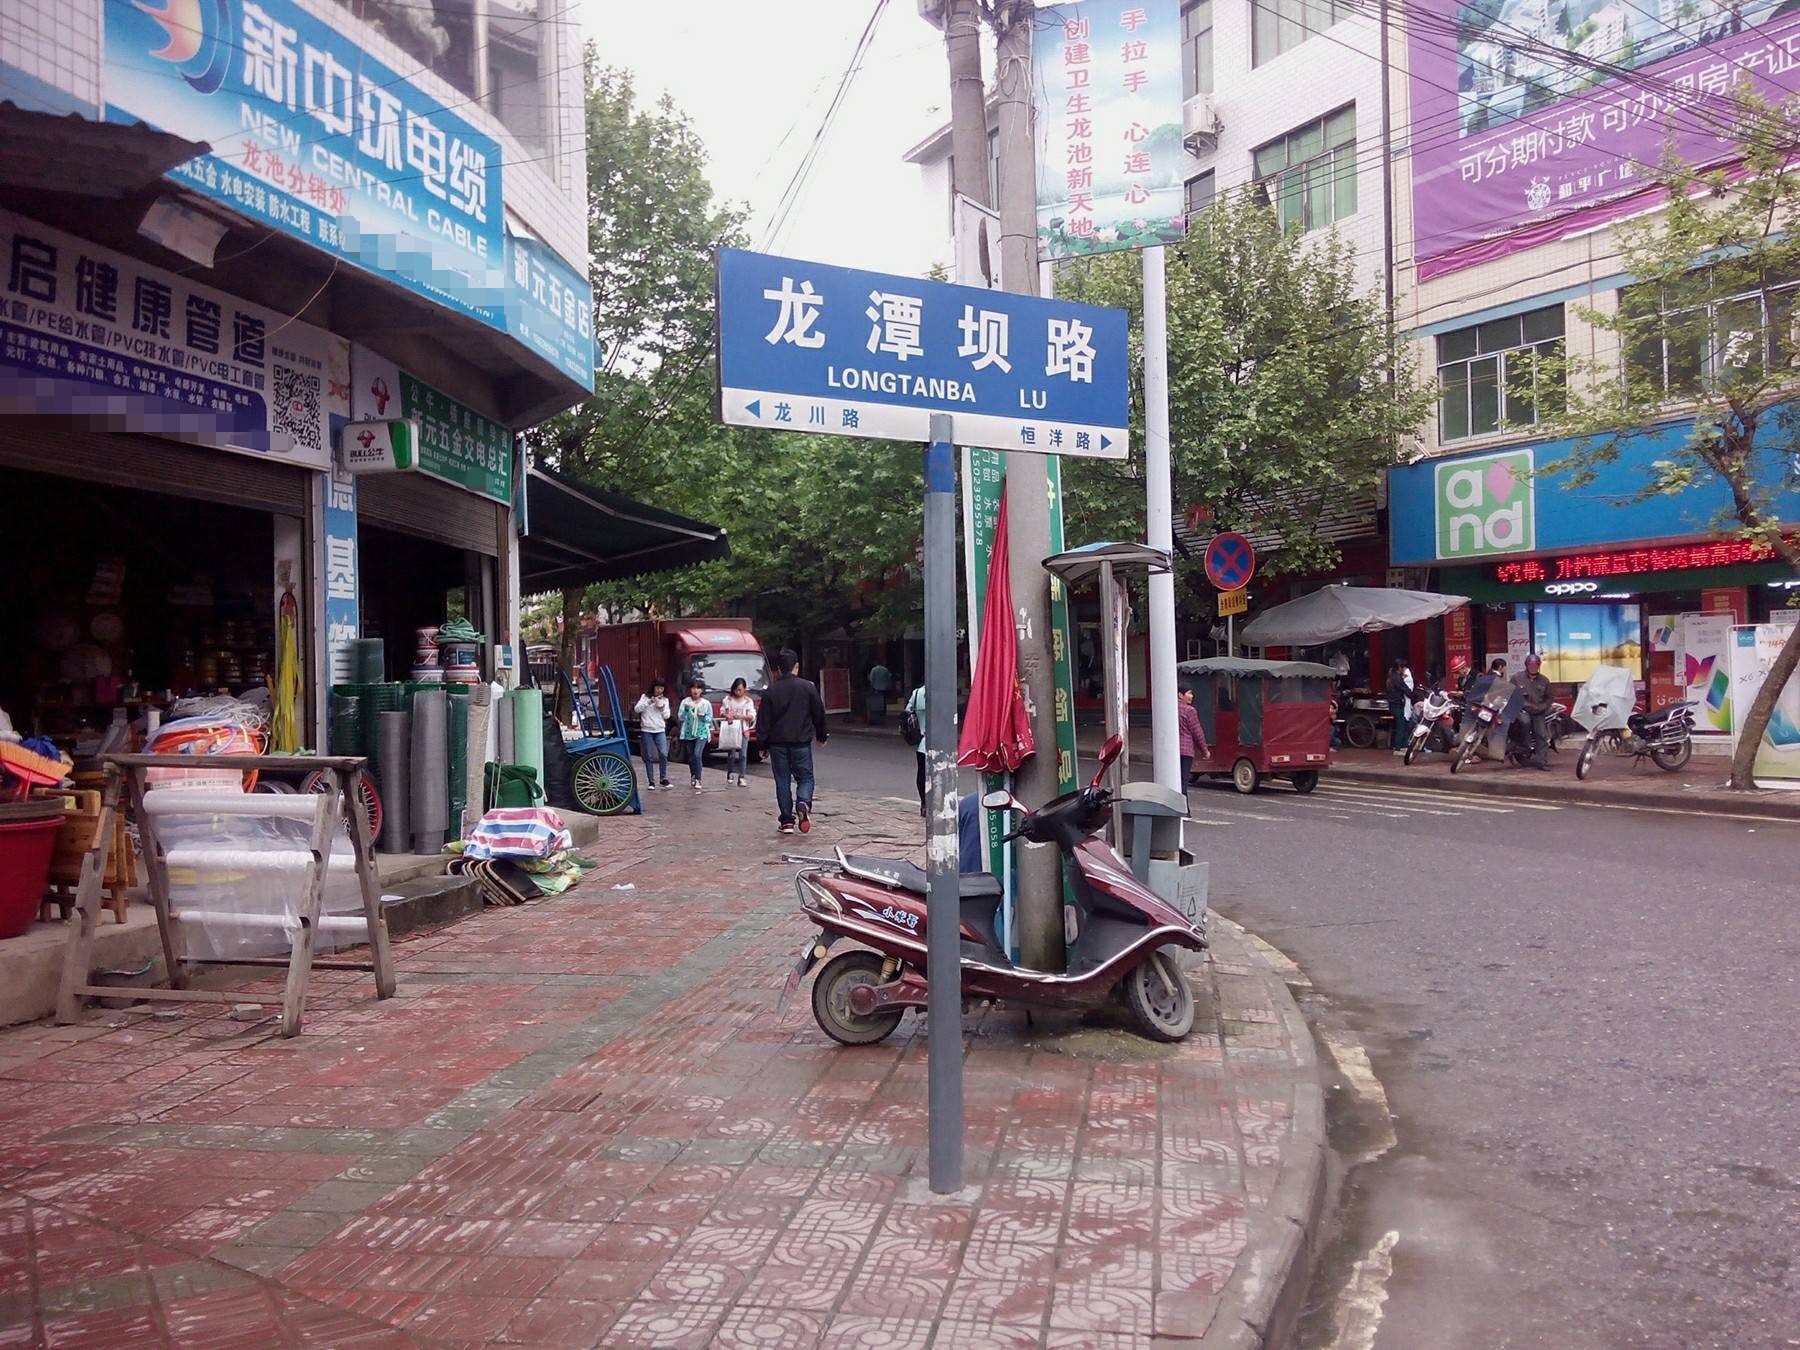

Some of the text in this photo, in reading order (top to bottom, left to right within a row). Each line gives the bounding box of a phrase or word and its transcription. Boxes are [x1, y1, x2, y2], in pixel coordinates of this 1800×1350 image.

[242, 1, 487, 223] 新中环电缆
[1064, 16, 1095, 238] 创建卫生龙池新天地
[1120, 8, 1150, 205] 手拉手 心连心
[1459, 111, 1597, 184] 可分期付款
[241, 103, 487, 258] NEW CENTRAL CABLE
[242, 140, 346, 213] 龙池分销处
[269, 193, 311, 234] 防水工程
[514, 243, 589, 339] 新元五金店
[763, 276, 1097, 384] 龙潭坝路
[774, 402, 860, 429] 龙川路
[828, 366, 1047, 409] LONGTANBA LU
[1020, 426, 1090, 450] 恒洋路
